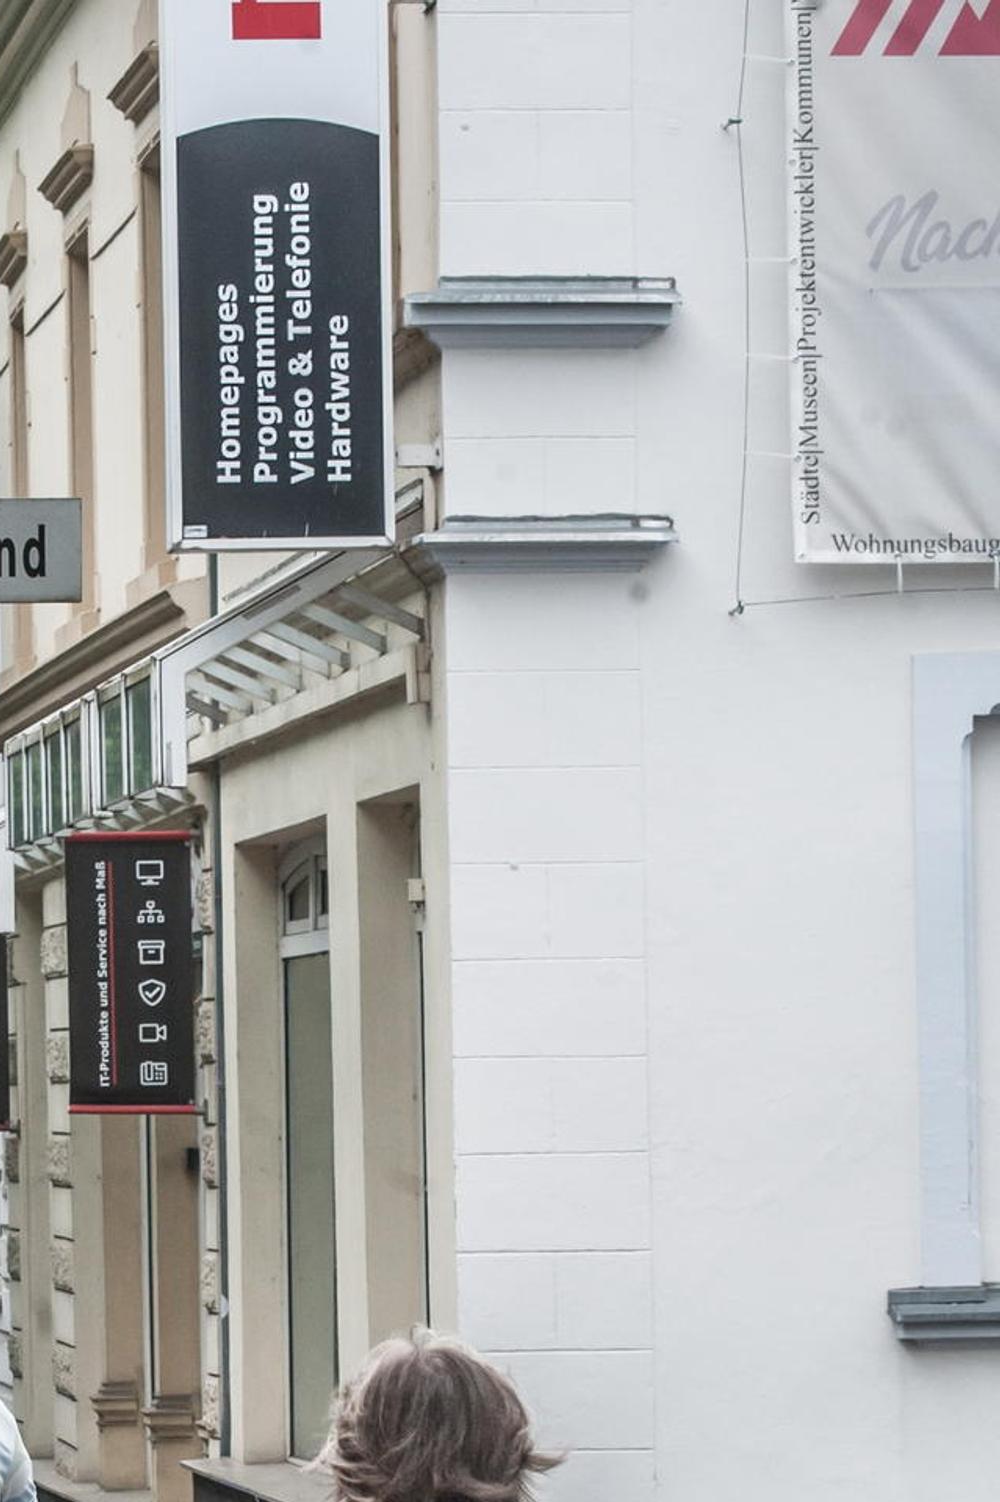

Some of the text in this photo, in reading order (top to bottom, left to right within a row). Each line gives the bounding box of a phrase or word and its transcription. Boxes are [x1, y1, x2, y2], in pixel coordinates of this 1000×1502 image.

[216, 283, 245, 484] Homepages
[249, 193, 281, 484] Programmierung
[284, 181, 315, 484] Video & Telefonie
[325, 313, 353, 483] Hardware
[95, 893, 107, 925] nach
[96, 928, 108, 978] Service
[98, 981, 109, 1007] und
[99, 1010, 111, 1088] IT-Produkte
